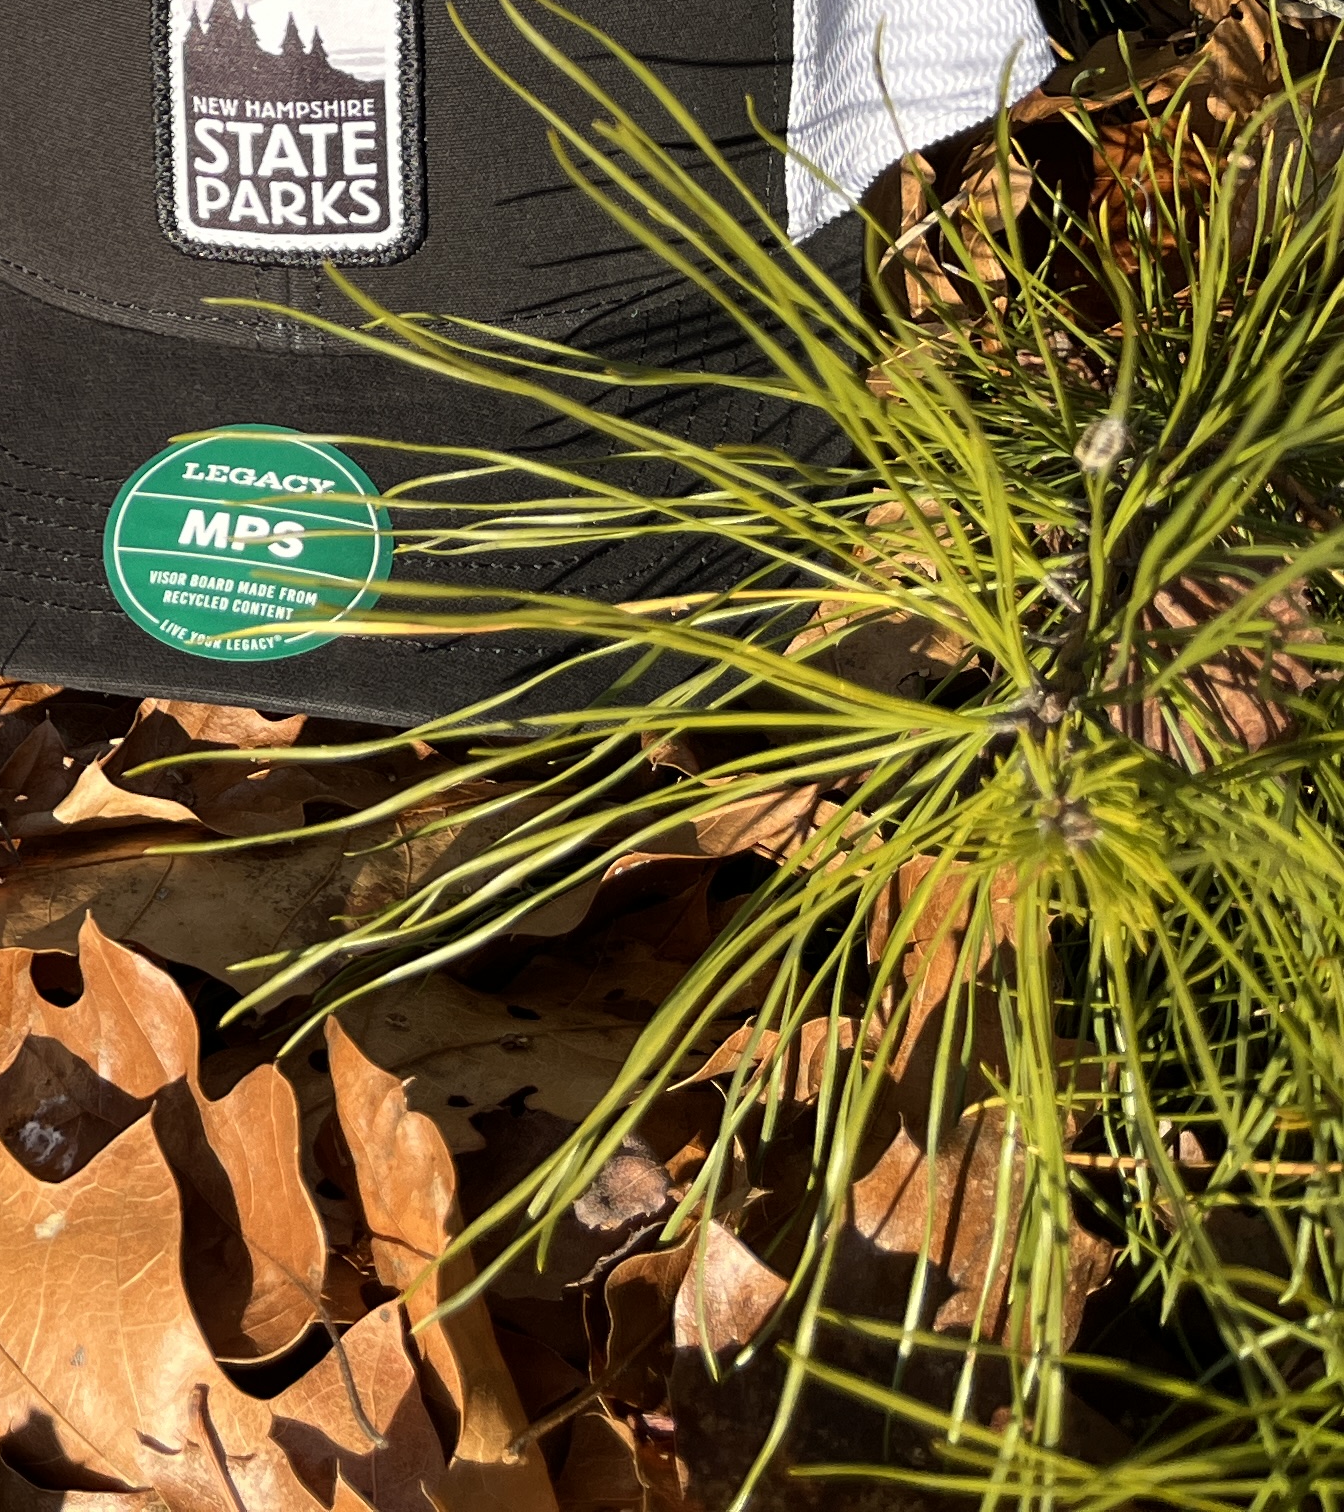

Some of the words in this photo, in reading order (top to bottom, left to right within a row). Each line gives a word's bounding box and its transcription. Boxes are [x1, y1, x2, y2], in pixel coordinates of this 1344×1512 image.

[192, 96, 239, 116] NEW
[245, 98, 375, 118] HAMPSHIRE
[193, 118, 378, 177] STATE
[195, 175, 381, 226] PARKS
[178, 509, 305, 558] MPS
[149, 570, 186, 586] VISOR
[190, 574, 235, 592] BOARD
[237, 580, 275, 598] MADE
[279, 587, 318, 606] FROM
[163, 590, 228, 611] RECYCLED
[232, 600, 294, 620] CONTENT
[159, 618, 186, 639] LIVE
